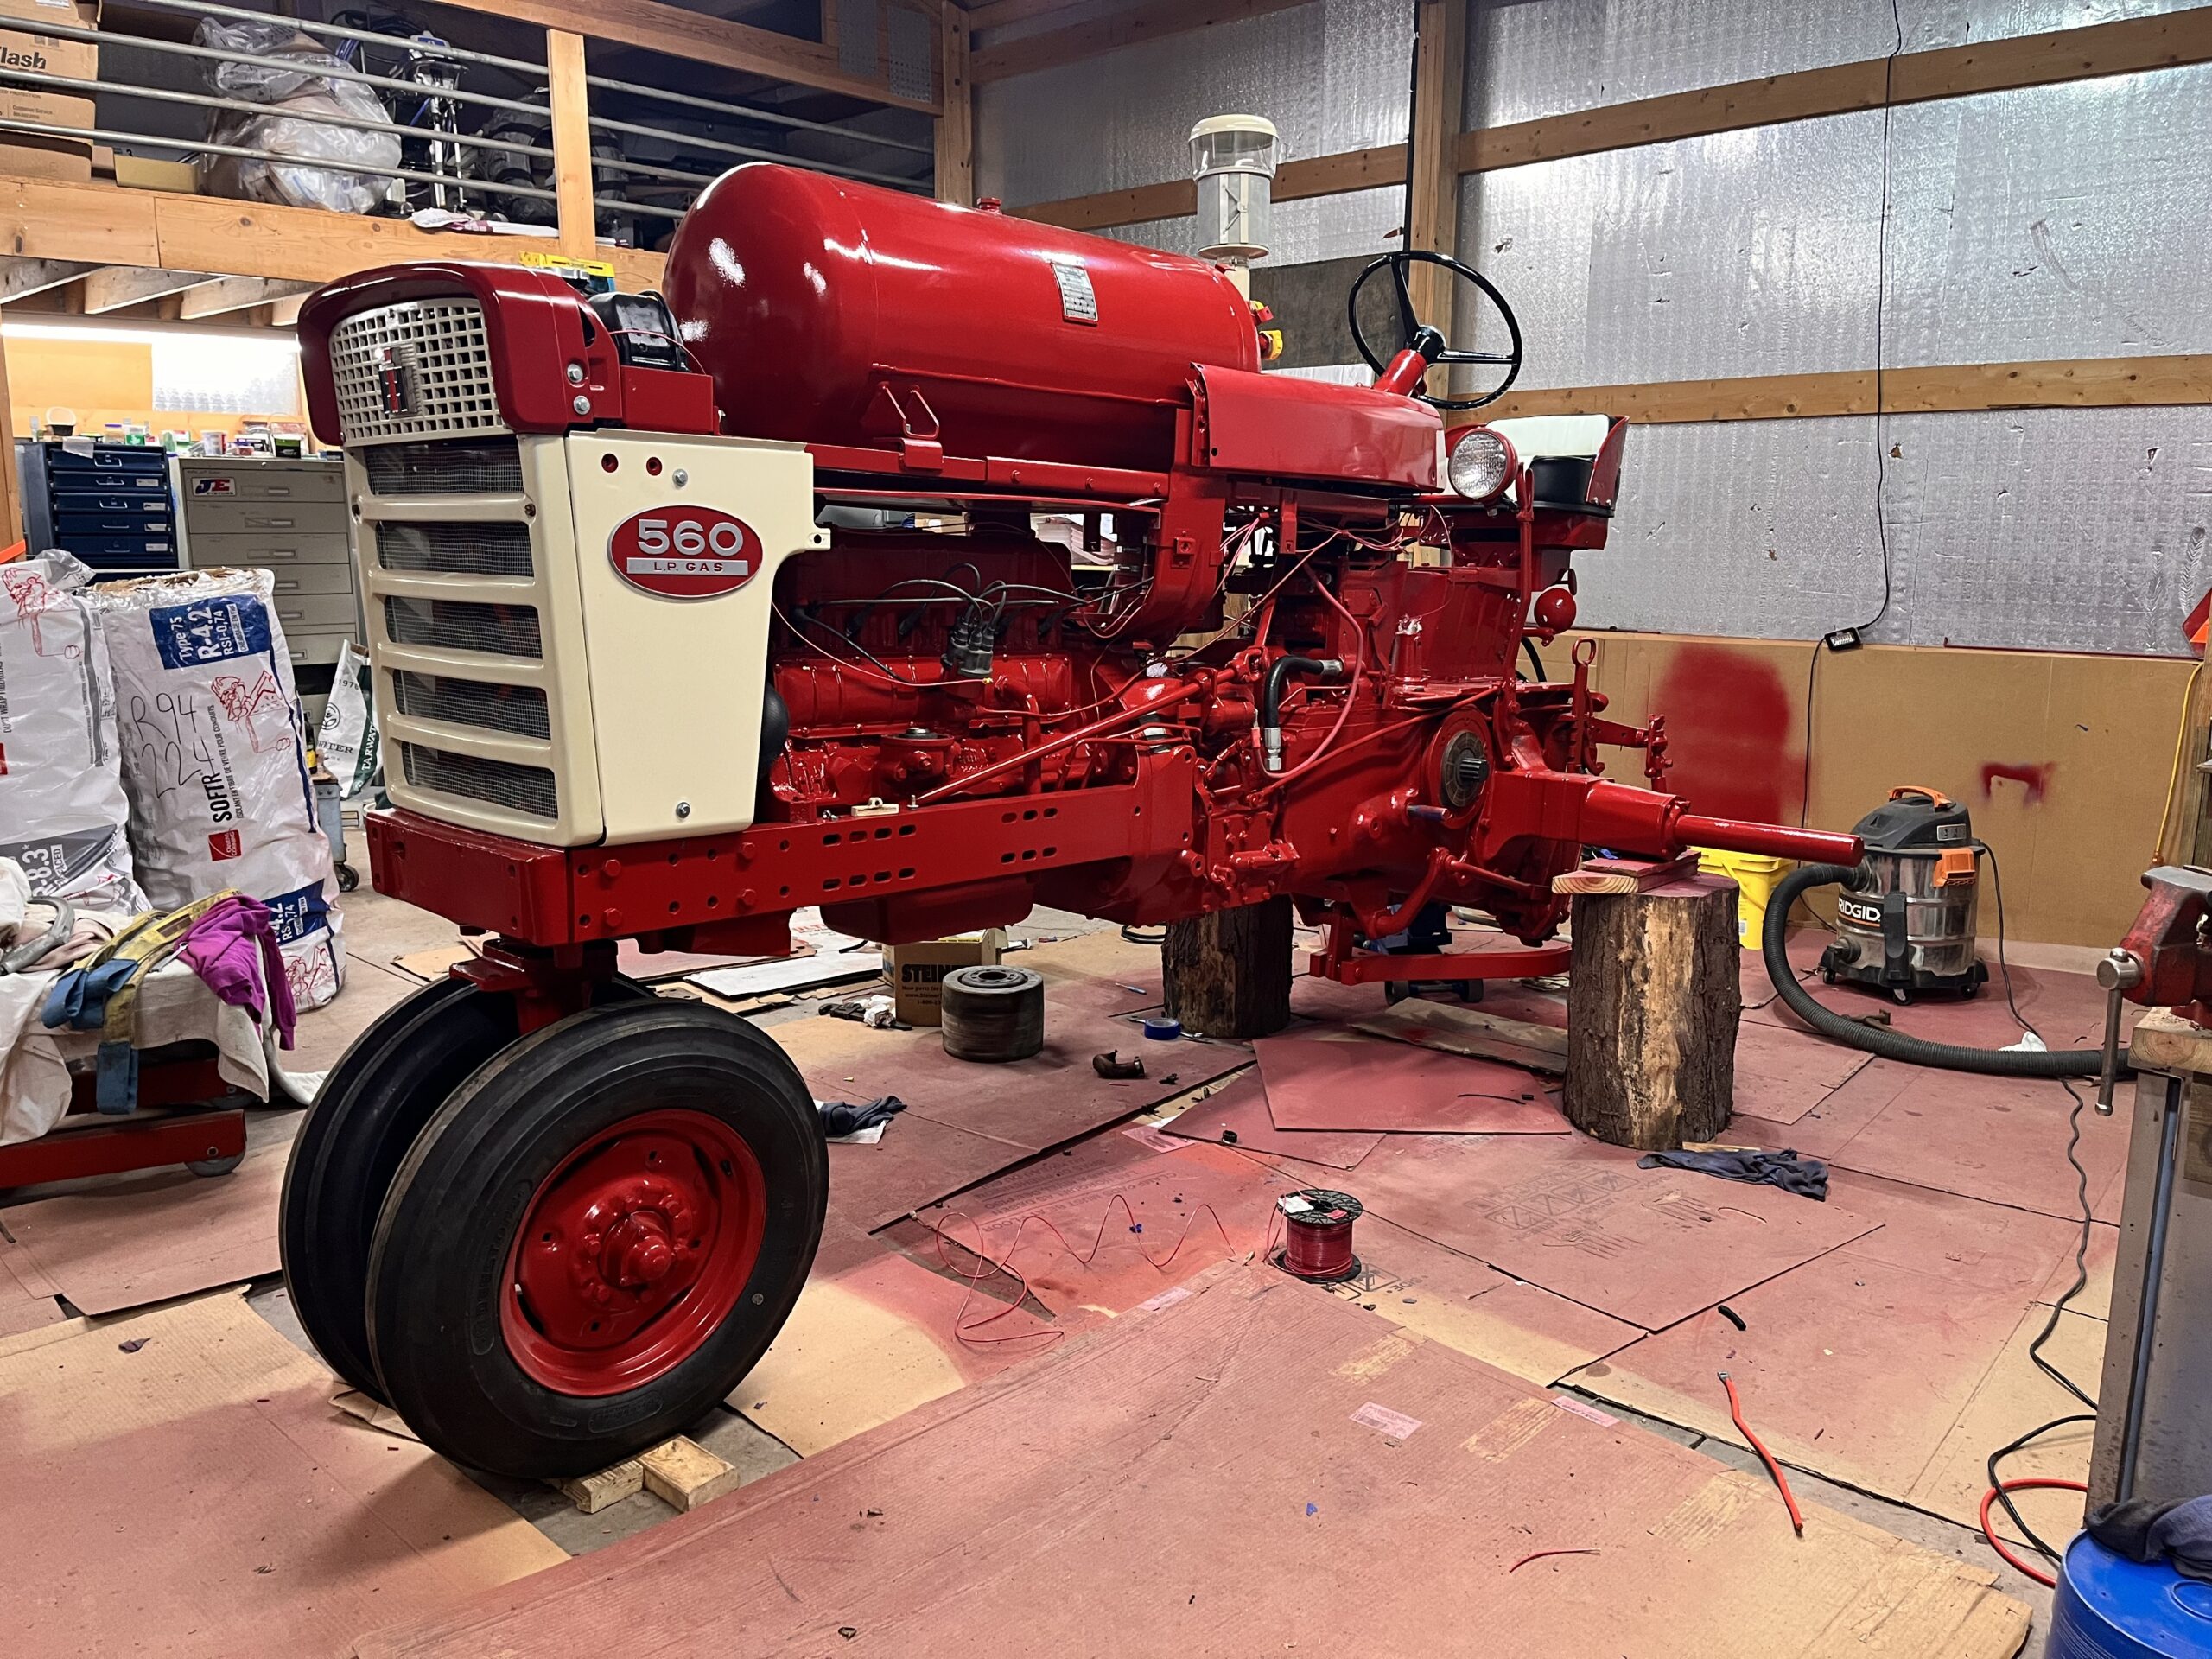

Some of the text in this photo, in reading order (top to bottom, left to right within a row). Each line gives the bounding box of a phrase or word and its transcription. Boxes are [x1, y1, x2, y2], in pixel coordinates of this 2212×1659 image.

[0, 46, 47, 70] lash
[195, 480, 230, 493] JE
[638, 518, 744, 556] 560
[653, 561, 724, 572] L.P. GAS
[169, 616, 194, 661] Type 75
[142, 736, 216, 799] 224
[1838, 897, 1880, 923] RIDGID
[1389, 1277, 1423, 1293] SIDE
